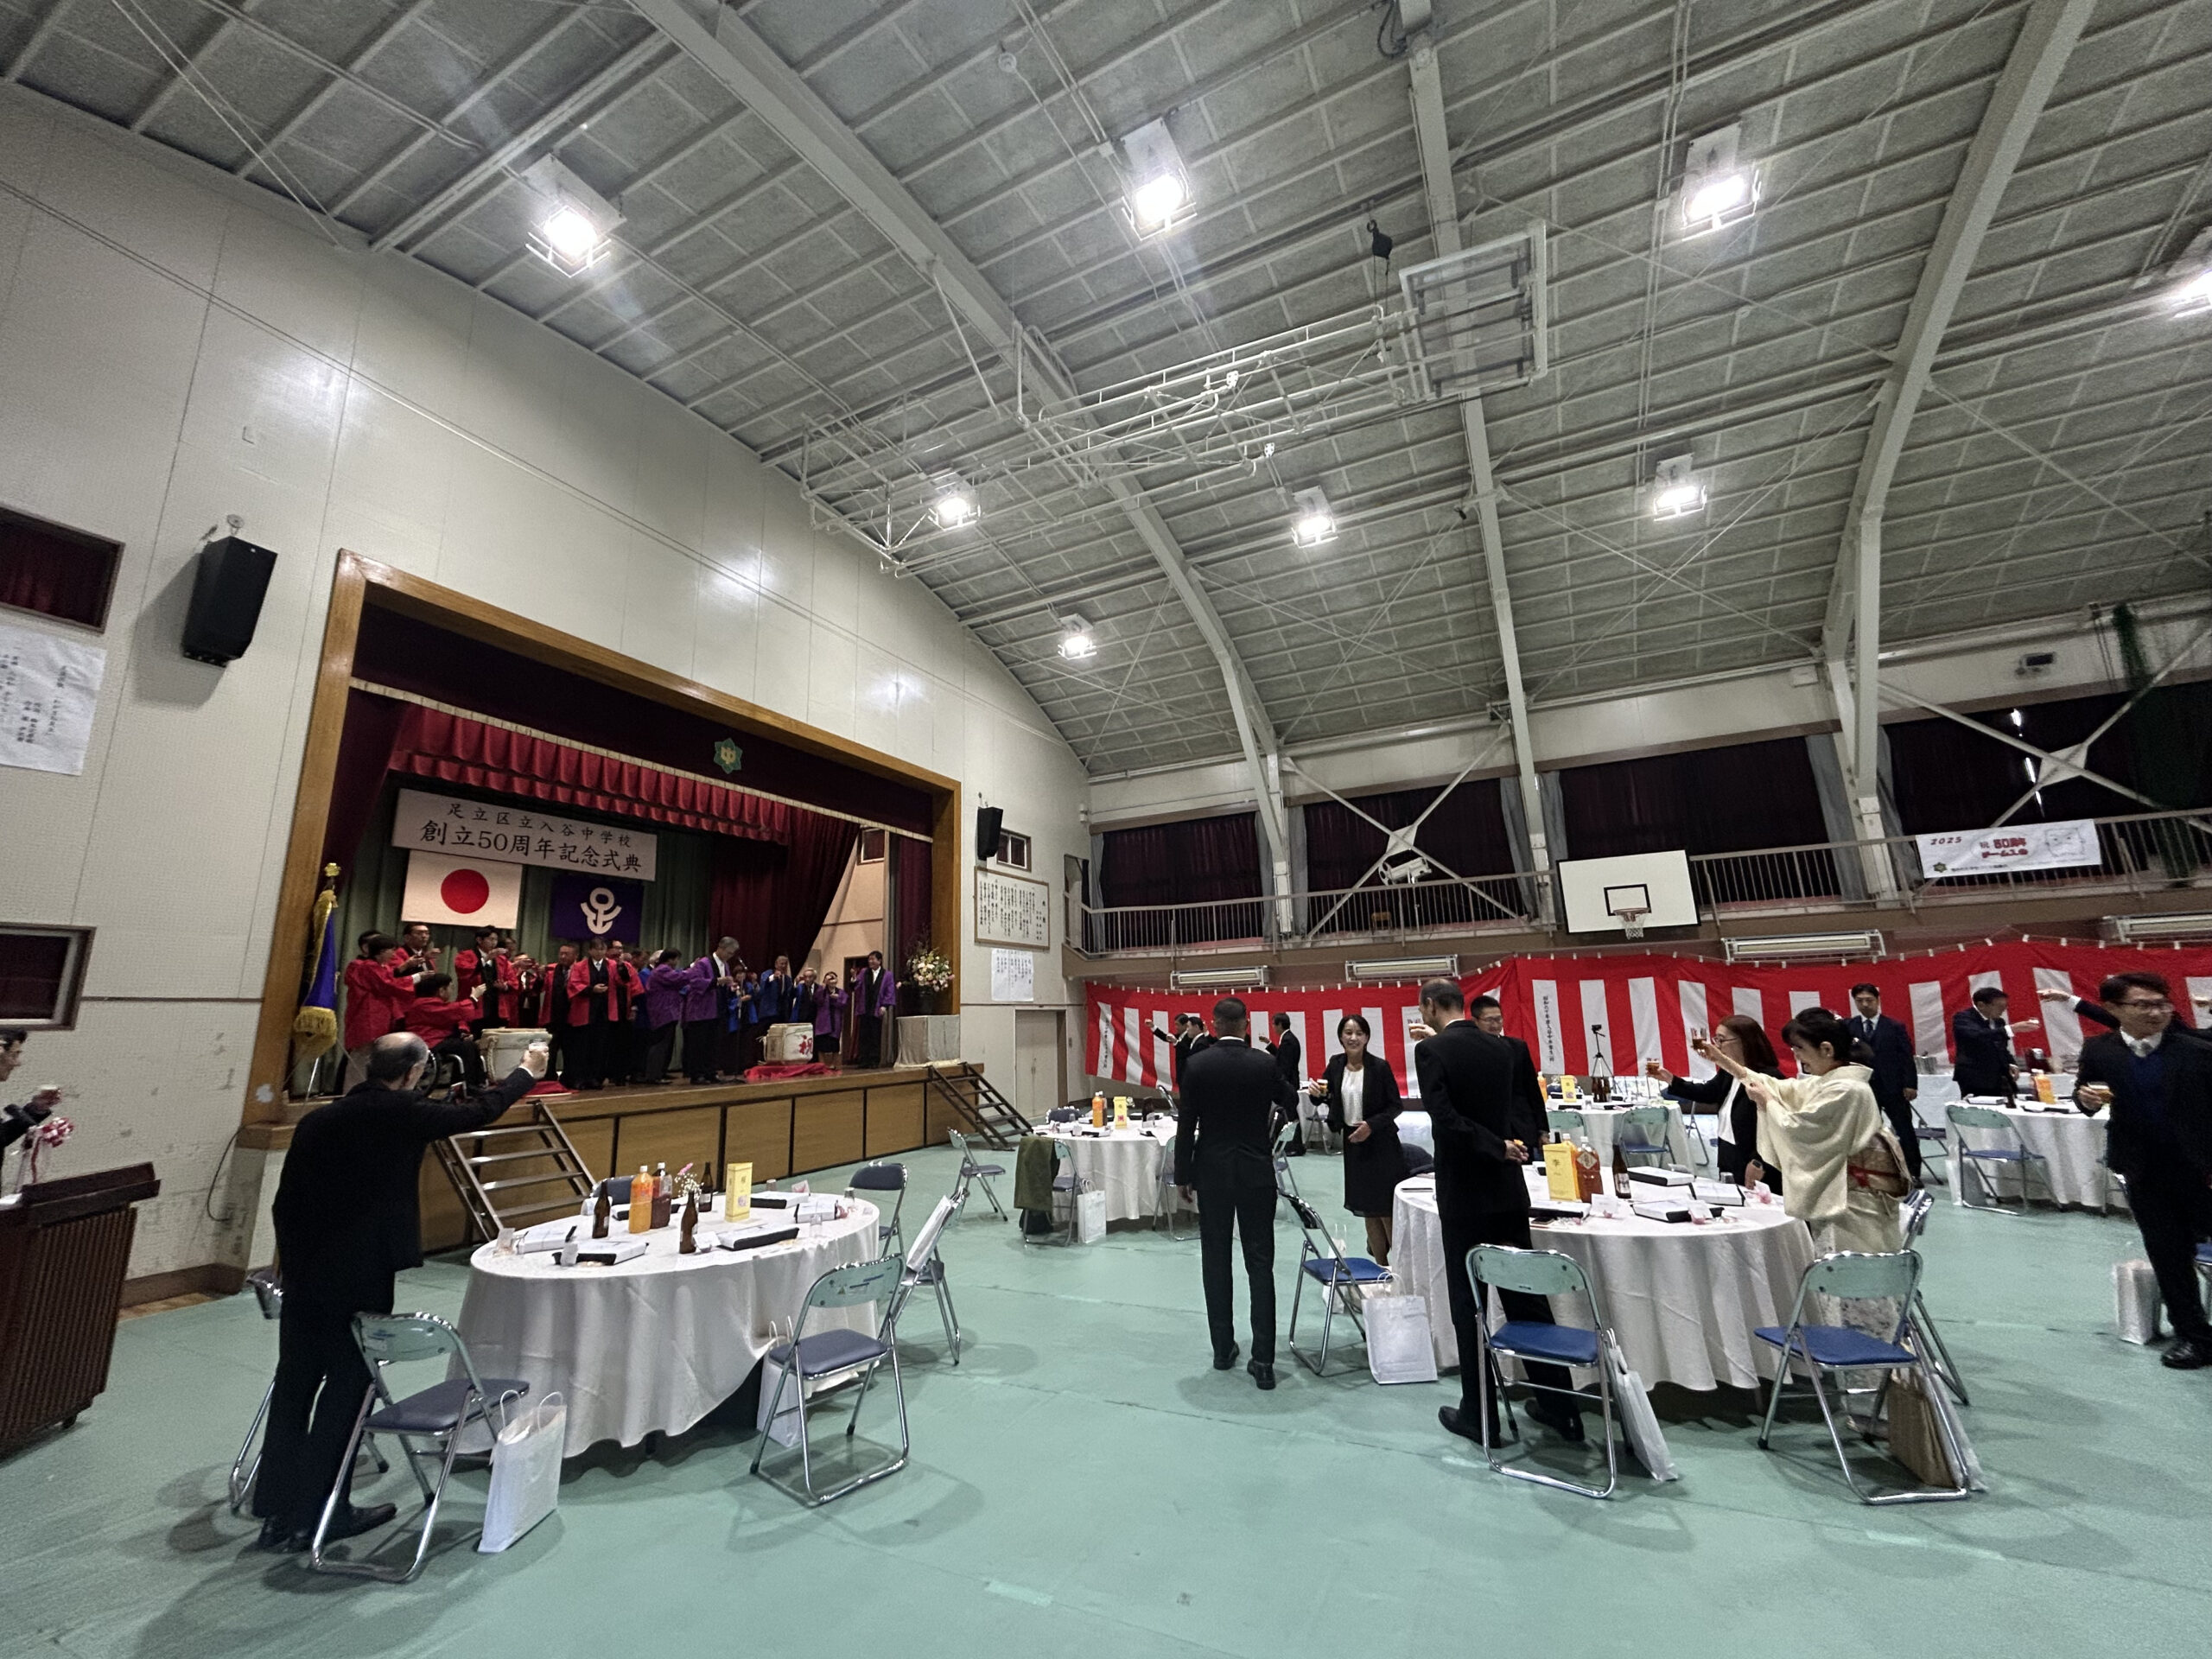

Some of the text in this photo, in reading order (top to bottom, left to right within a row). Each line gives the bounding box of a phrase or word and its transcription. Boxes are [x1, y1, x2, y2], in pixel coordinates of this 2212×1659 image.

[420, 820, 642, 874] 創立50周年記念式典
[447, 803, 631, 848] 足立区立入谷中学校
[1930, 836, 1962, 846] 2025
